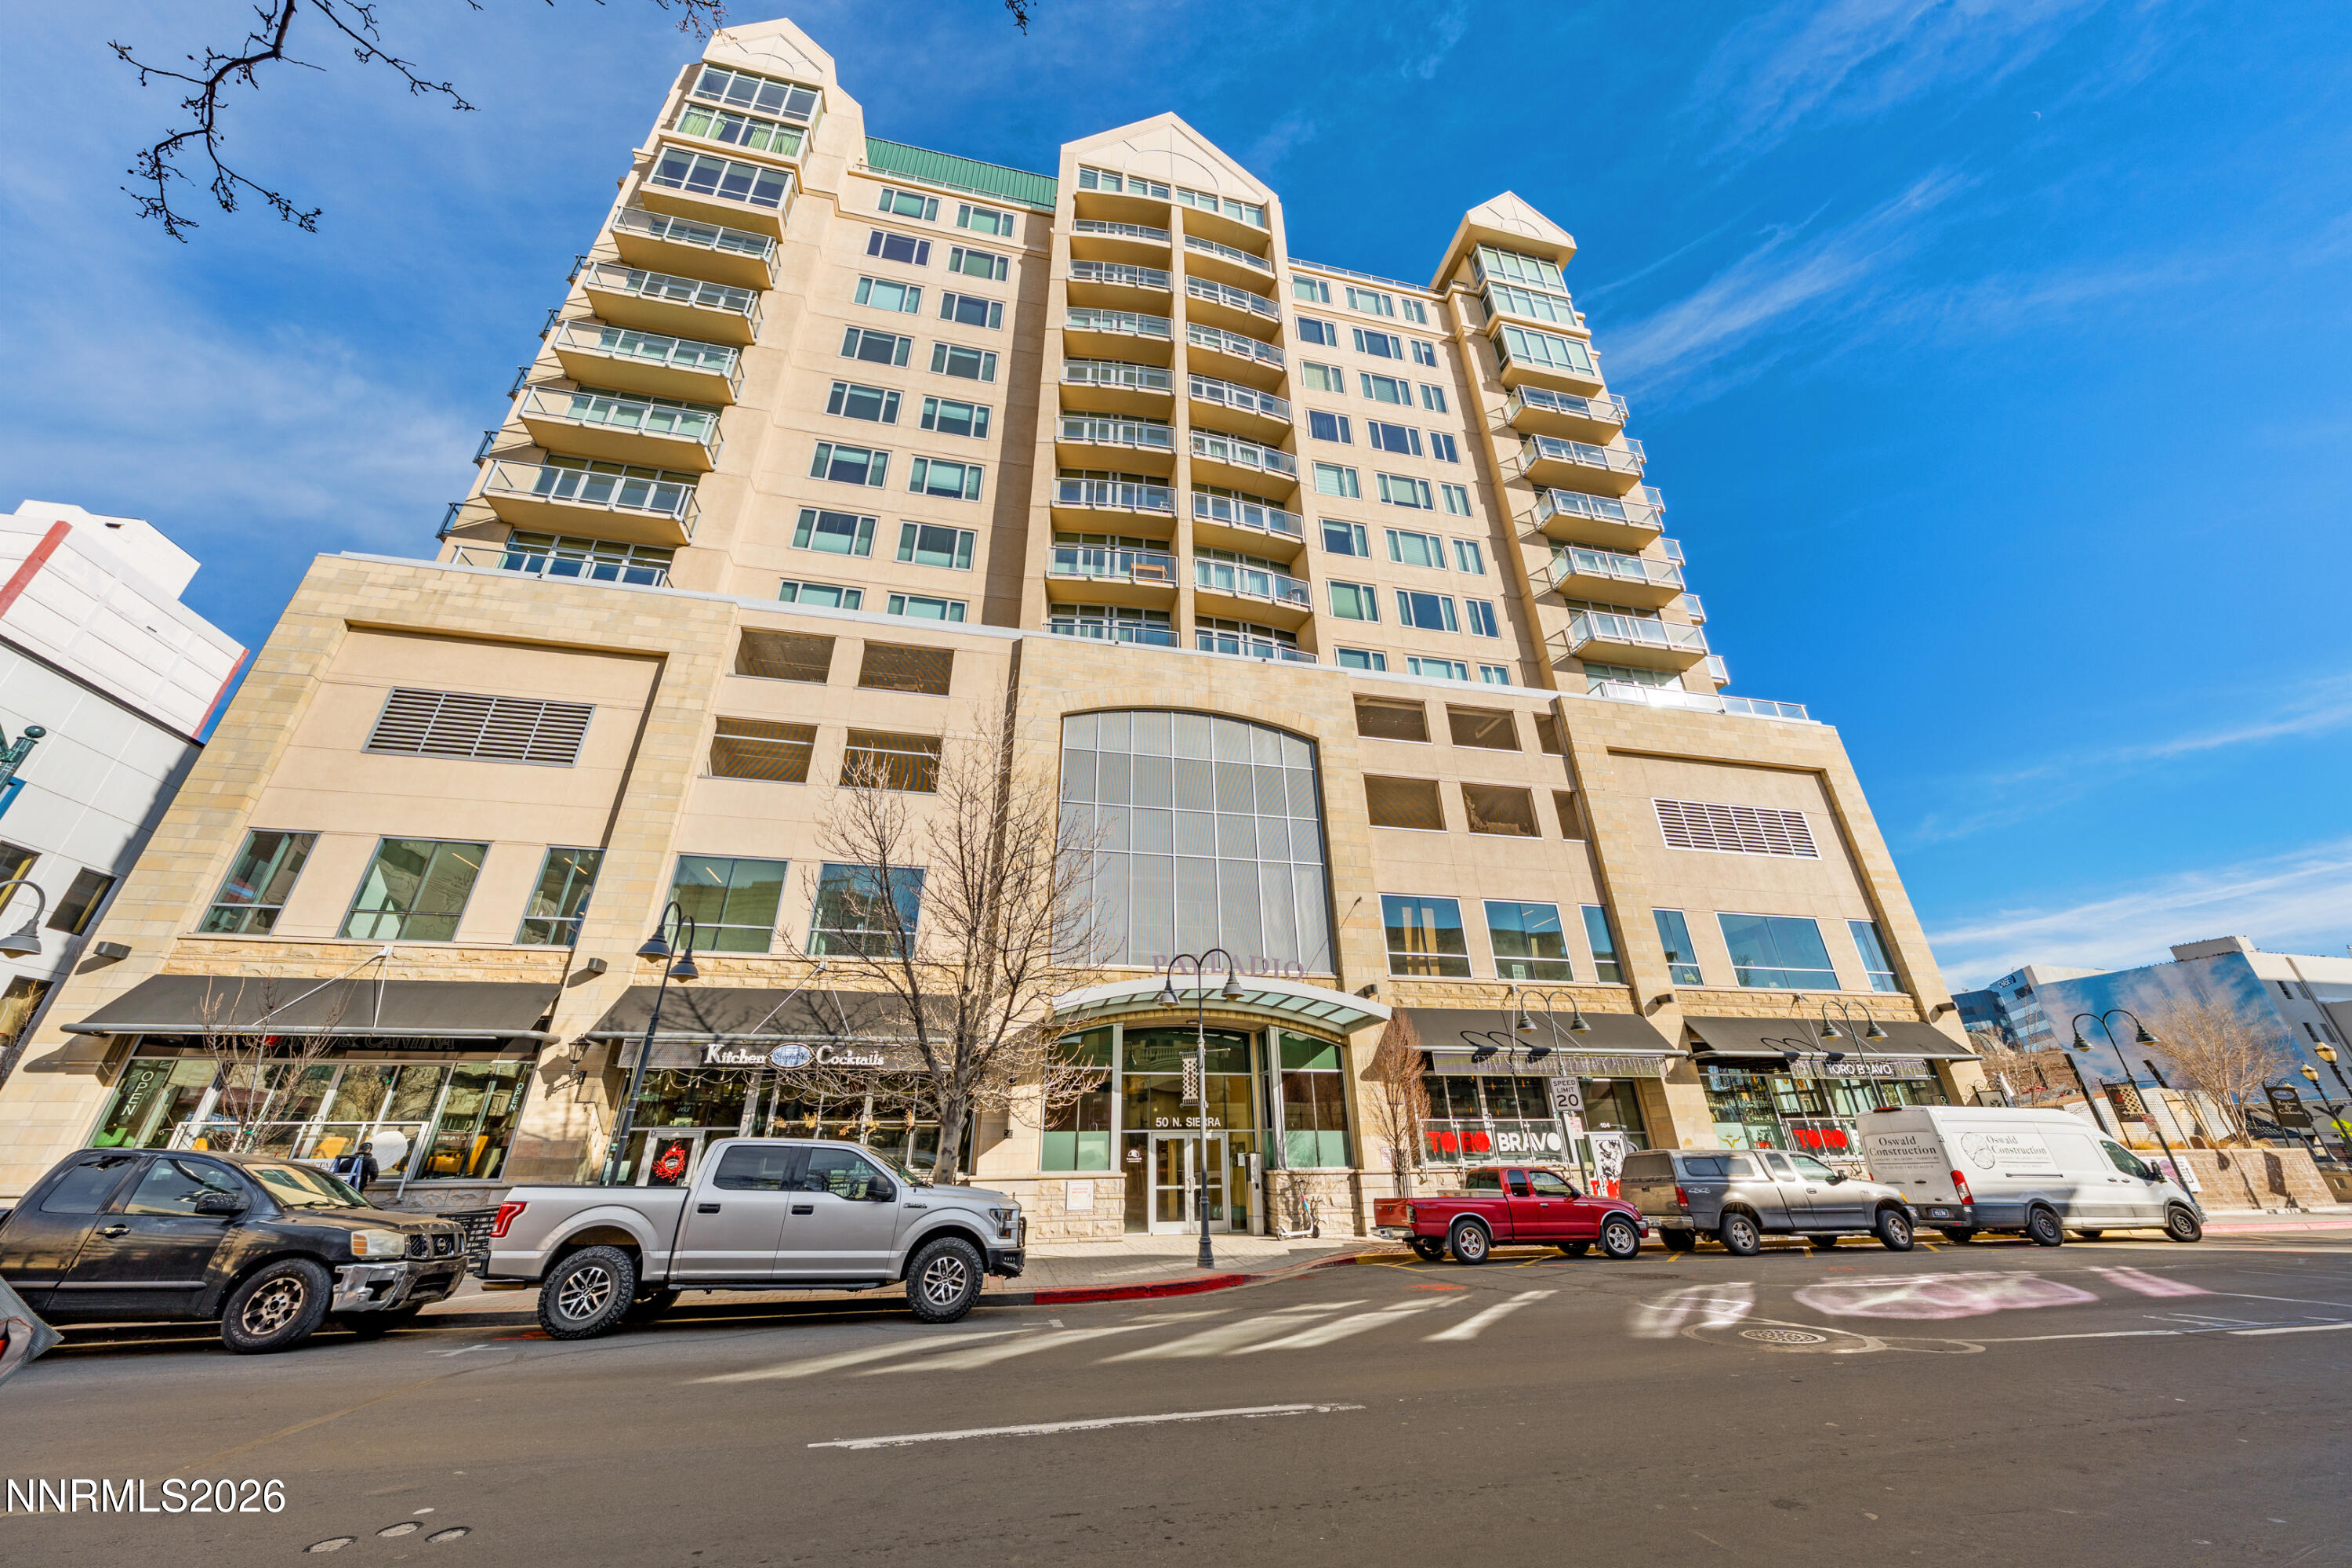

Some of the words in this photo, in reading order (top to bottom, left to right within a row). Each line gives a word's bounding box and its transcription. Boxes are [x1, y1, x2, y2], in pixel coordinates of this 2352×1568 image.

[1152, 954, 1305, 981] PALLADIO
[704, 1044, 767, 1065] Kitchen
[815, 1044, 884, 1065] Cocktails
[1828, 1063, 1855, 1075] TORO
[121, 1071, 154, 1116] OPEN
[508, 1083, 524, 1111] OPEN
[1557, 1094, 1579, 1107] 20
[1155, 1116, 1170, 1127] 50
[1172, 1116, 1182, 1127] N.
[1425, 1131, 1490, 1153] TORO
[1496, 1131, 1562, 1152] BRAVO
[1792, 1129, 1849, 1149] TORO
[1878, 1135, 1916, 1146] Oswald
[1986, 1134, 2019, 1145] Oswald
[1869, 1145, 1936, 1156] Construction
[1991, 1145, 2047, 1155] Construction
